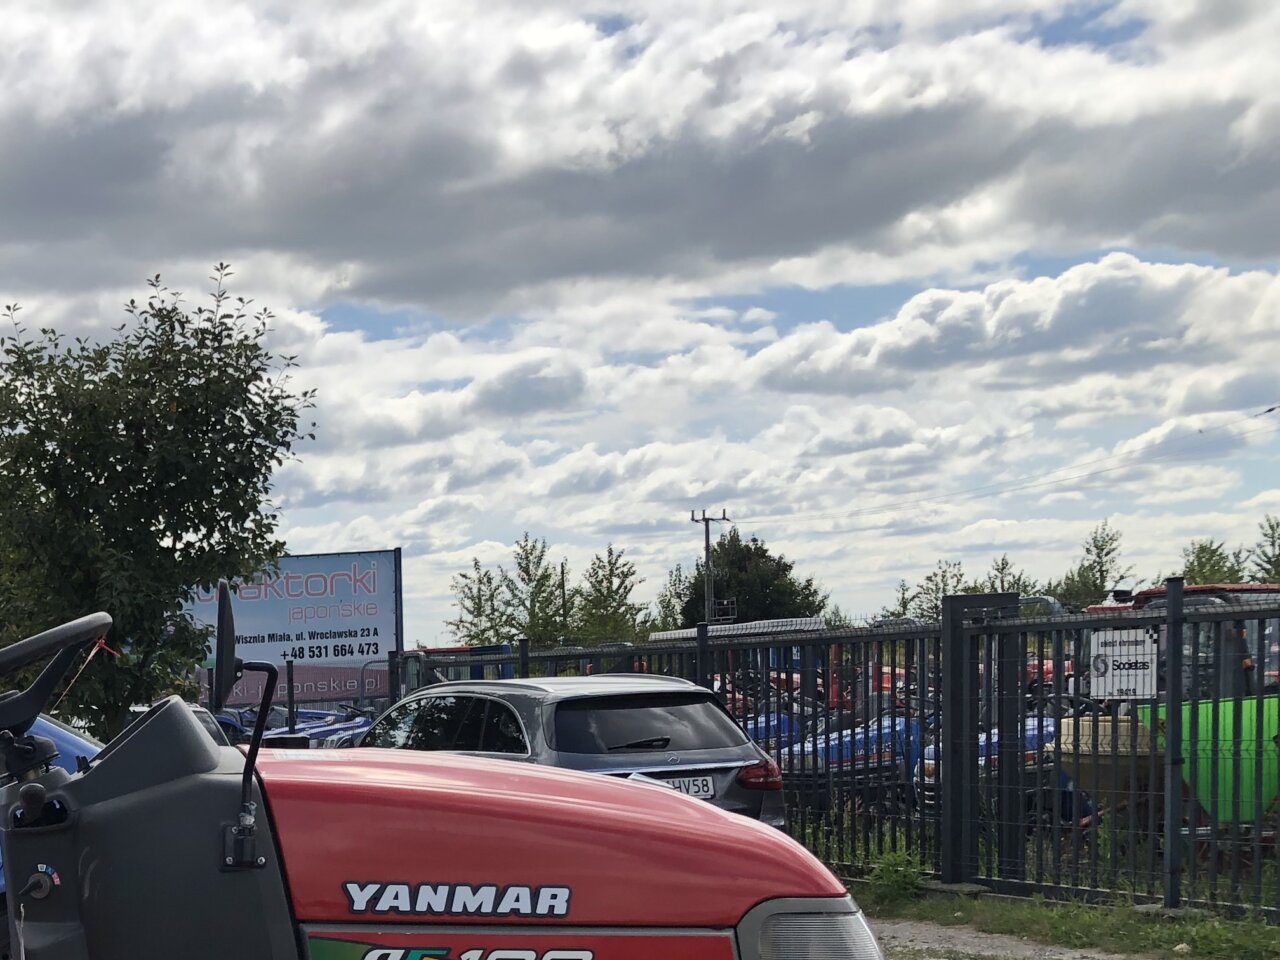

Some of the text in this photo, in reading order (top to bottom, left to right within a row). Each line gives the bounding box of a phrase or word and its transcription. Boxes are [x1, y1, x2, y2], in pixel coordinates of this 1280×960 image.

[195, 561, 378, 604] aktorki
[295, 631, 305, 642] ul.
[360, 628, 370, 638] 23
[372, 627, 379, 637] A
[280, 642, 379, 660] +48 531 664 473
[1112, 659, 1150, 670] Societas
[667, 778, 710, 794] HV58
[345, 882, 571, 916] YANMAR
